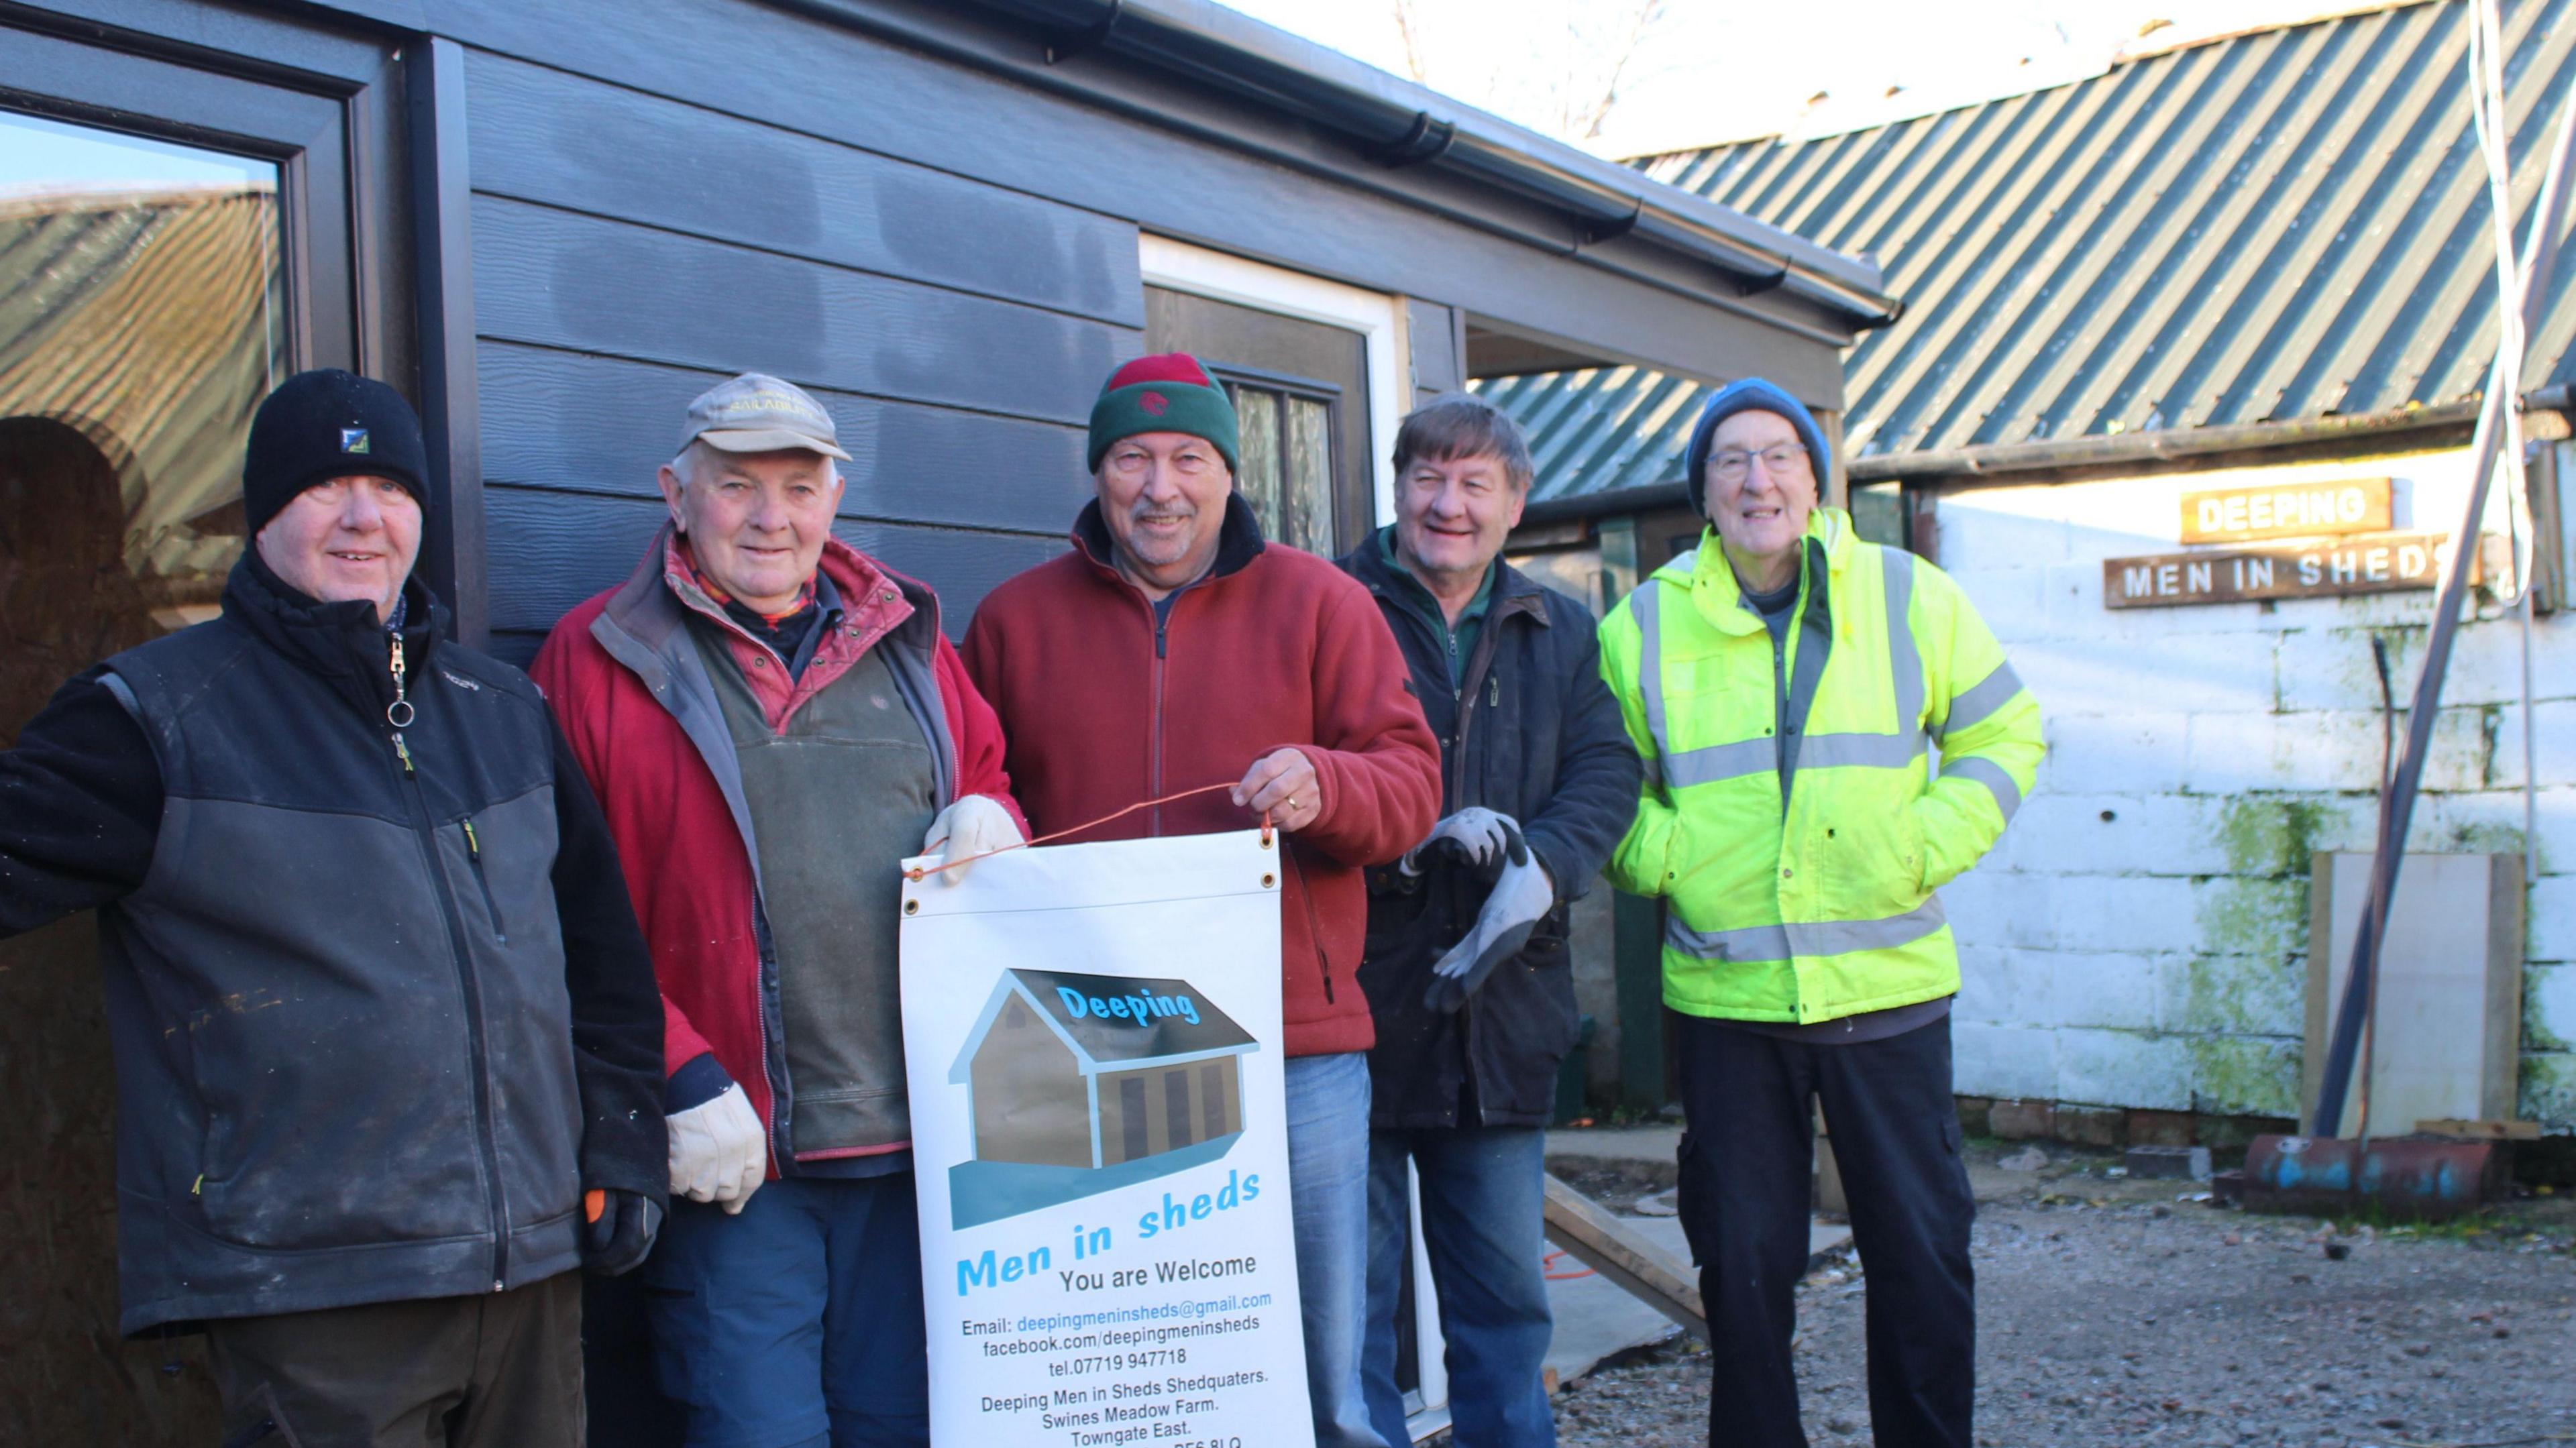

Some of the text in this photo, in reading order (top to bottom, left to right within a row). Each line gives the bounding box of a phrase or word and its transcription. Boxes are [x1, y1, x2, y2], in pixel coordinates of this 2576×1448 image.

[2198, 487, 2365, 533] DEEPING
[2125, 561, 2213, 598] MEN
[2233, 557, 2275, 591] IN
[1057, 987, 1200, 1027] Deeping
[957, 1168, 1260, 1298] Men in sheds
[1059, 1256, 1257, 1292] You are Welcome
[962, 1292, 1272, 1336] Email: deepingmeninsheds@gmail.com
[983, 1315, 1260, 1357] facebook.com/deepingmeninsheds
[1049, 1348, 1187, 1377] tel.07719 947718
[981, 1370, 1269, 1414] Deeping Men in Sheds Shedquaters.
[1042, 1399, 1220, 1430] Swines Meadow Farm.
[1070, 1421, 1192, 1447] Towngate East.
